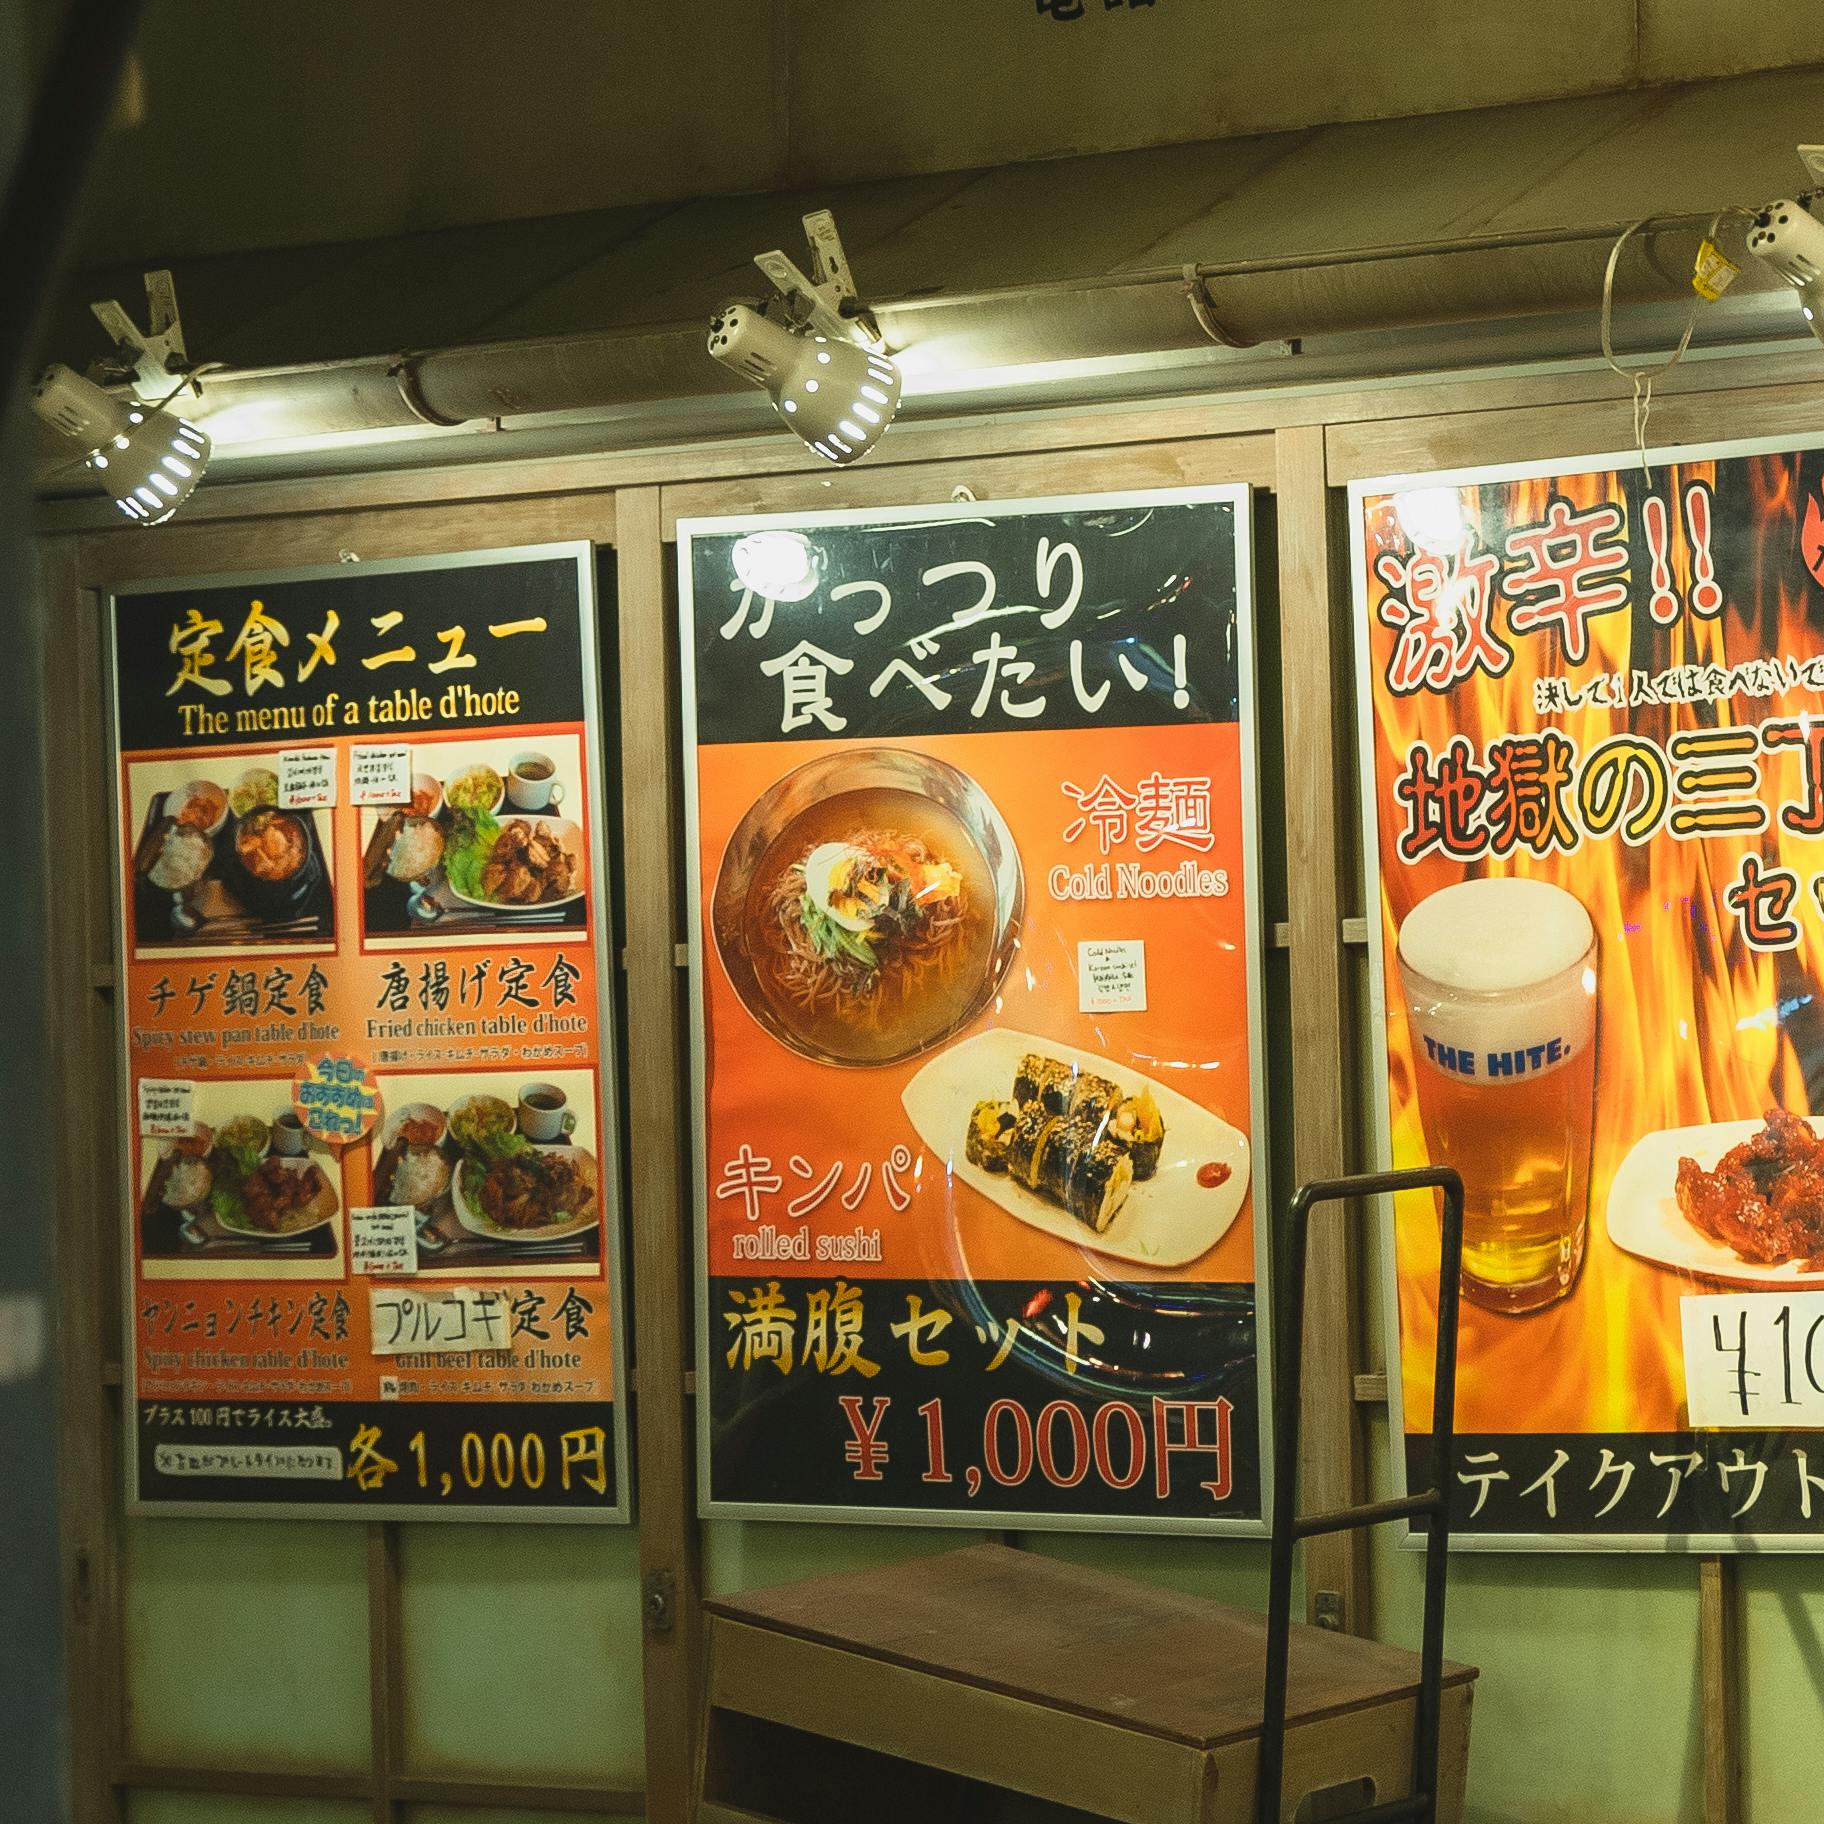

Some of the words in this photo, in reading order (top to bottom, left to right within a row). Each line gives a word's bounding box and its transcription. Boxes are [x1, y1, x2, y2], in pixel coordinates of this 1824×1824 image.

[165, 599, 548, 696] 定食メニュー
[178, 703, 229, 736] The
[235, 703, 307, 733] menu
[312, 693, 339, 726] of
[343, 699, 360, 726] a
[367, 690, 433, 724] table
[439, 686, 520, 719] d'hote
[760, 633, 1190, 733] 食べたい!
[1061, 771, 1215, 856] 冷麺
[1048, 863, 1113, 901] Cold
[1115, 860, 1229, 900] Noodles
[147, 963, 329, 1017] チゲ鍋定食
[376, 953, 581, 1012] 唐揚げ定食
[180, 1028, 217, 1047] stew
[221, 1028, 251, 1049] pan
[255, 1023, 294, 1043] table
[366, 1018, 412, 1039] Fried
[416, 1017, 476, 1037] chicken
[482, 1014, 527, 1035] table
[1423, 1034, 1476, 1076] THE
[716, 1144, 912, 1221] キンパ
[732, 1224, 810, 1261] rolled
[815, 1226, 883, 1263] sushi
[722, 1280, 1105, 1377] 満腹セット
[478, 1349, 520, 1369] table
[347, 1423, 607, 1496] 各1,000円
[838, 1395, 1234, 1501] ¥1,000円
